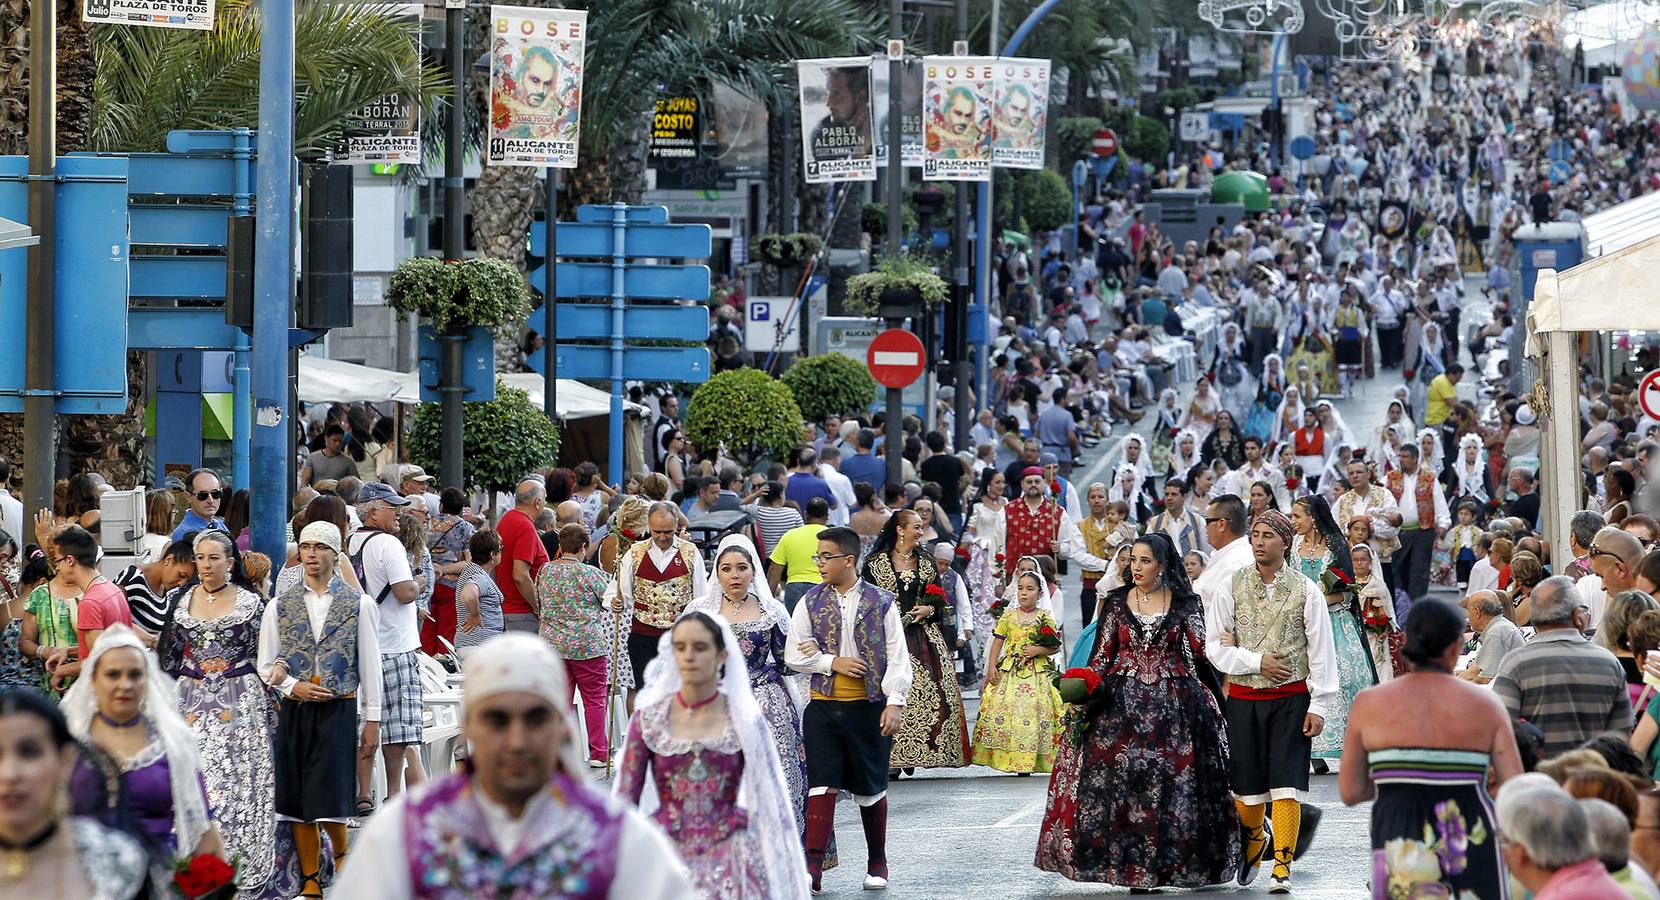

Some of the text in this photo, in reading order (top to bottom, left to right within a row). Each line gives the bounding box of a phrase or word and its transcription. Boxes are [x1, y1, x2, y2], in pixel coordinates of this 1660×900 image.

[88, 5, 109, 16] Julio
[113, 1, 149, 9] PLAZA
[153, 3, 167, 11] DE
[170, 4, 208, 14] TOROS
[496, 16, 580, 38] BOSE
[927, 66, 992, 79] BOSE
[1004, 67, 1047, 79] OSE
[667, 97, 698, 112] JOYAS
[654, 113, 695, 130] COSTO
[821, 125, 857, 138] PABLO
[350, 138, 418, 146] ALICANTE
[492, 138, 504, 152] 11
[506, 140, 574, 150] ALICANTE
[547, 148, 575, 156] TOROS
[809, 163, 818, 174] 7
[820, 160, 873, 168] ALICANTE
[752, 303, 768, 320] P
